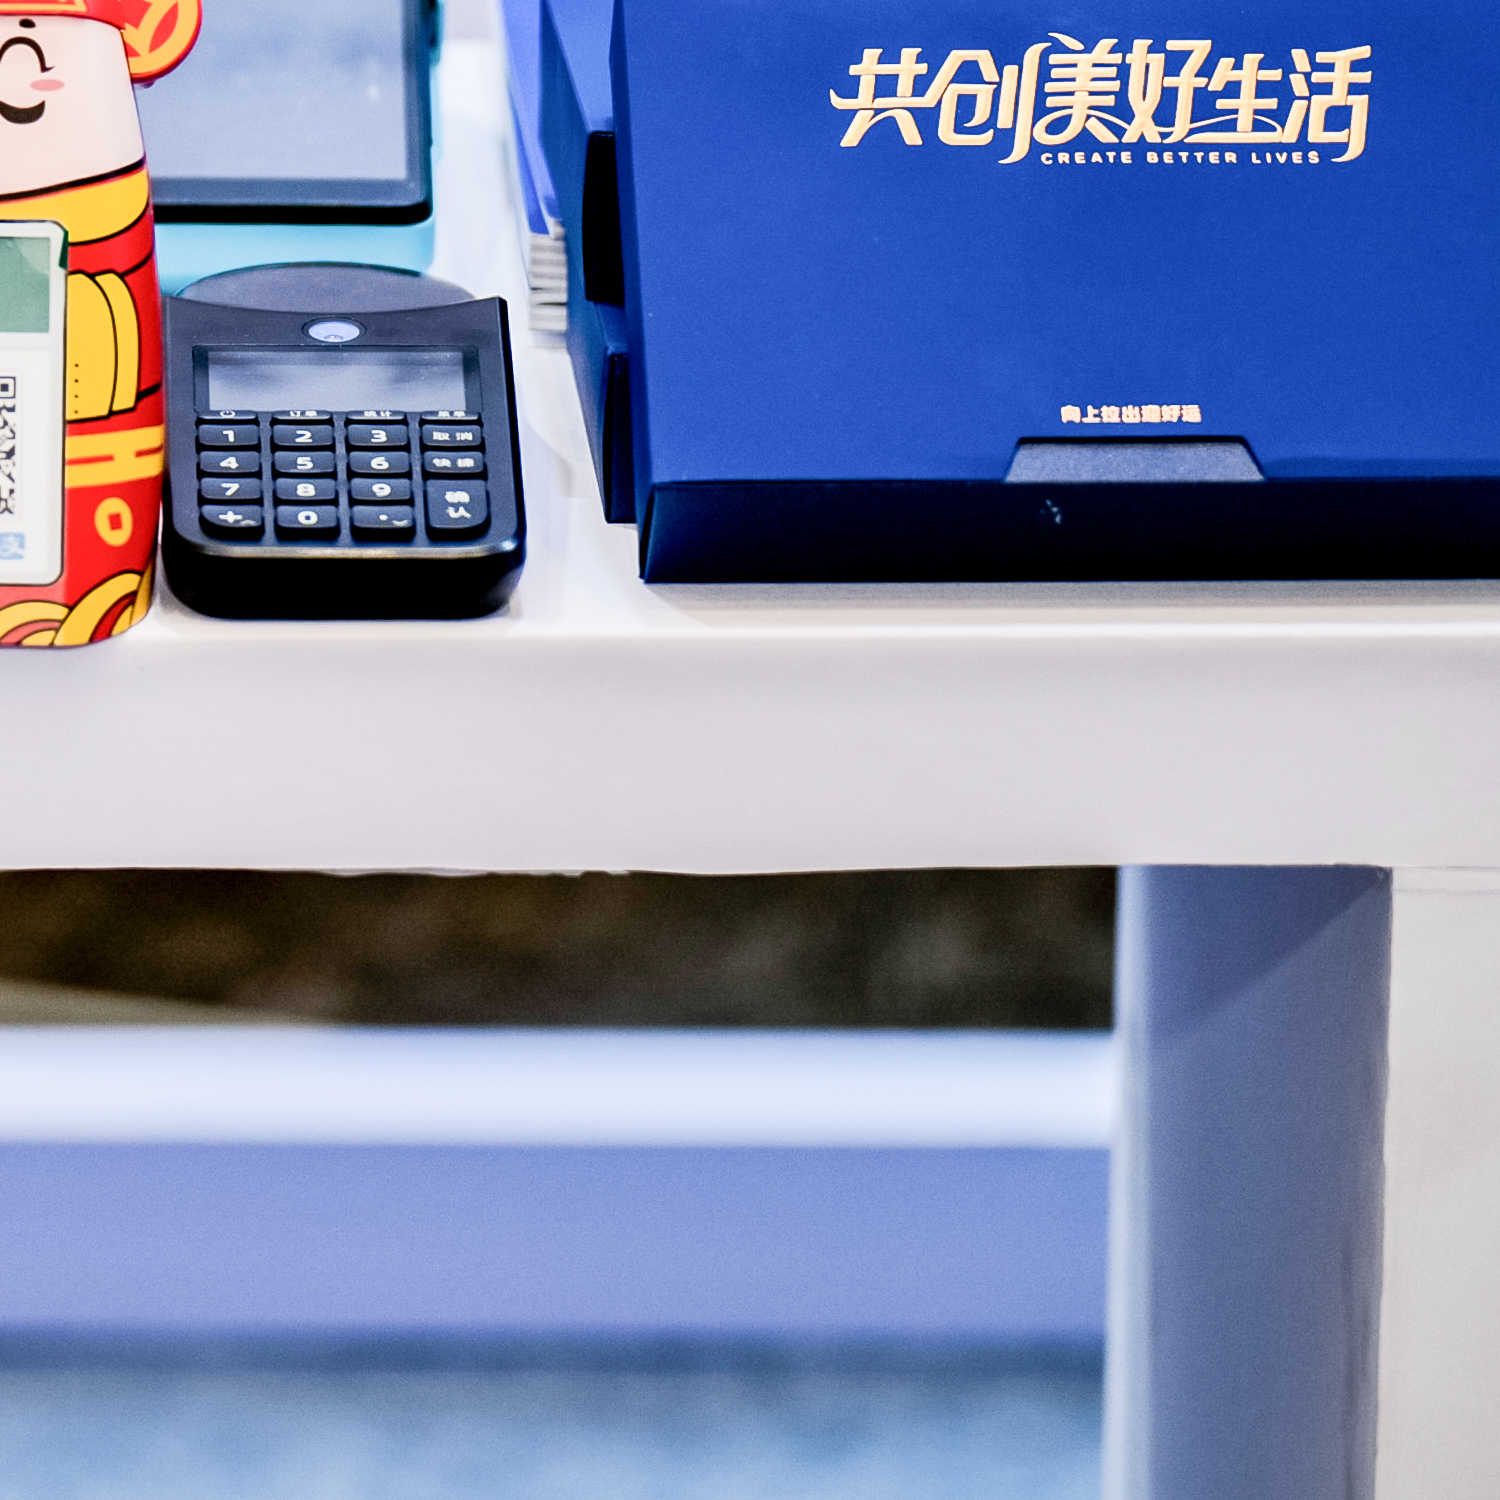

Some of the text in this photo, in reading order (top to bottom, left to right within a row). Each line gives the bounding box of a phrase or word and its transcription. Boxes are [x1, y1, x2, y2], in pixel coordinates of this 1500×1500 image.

[830, 32, 1373, 164] 共创美好生活
[1040, 151, 1320, 164] CREATE BETTER LIVES
[1060, 405, 1202, 424] 向上拉出迎好运
[222, 430, 236, 443] 1
[295, 430, 313, 443] 2
[371, 430, 388, 443] 3
[219, 456, 239, 470] 4
[296, 456, 314, 470] 5
[370, 456, 389, 470] 6
[220, 483, 240, 496] 7
[296, 483, 316, 497] 8
[371, 483, 392, 497] 9
[297, 510, 319, 525] 0
